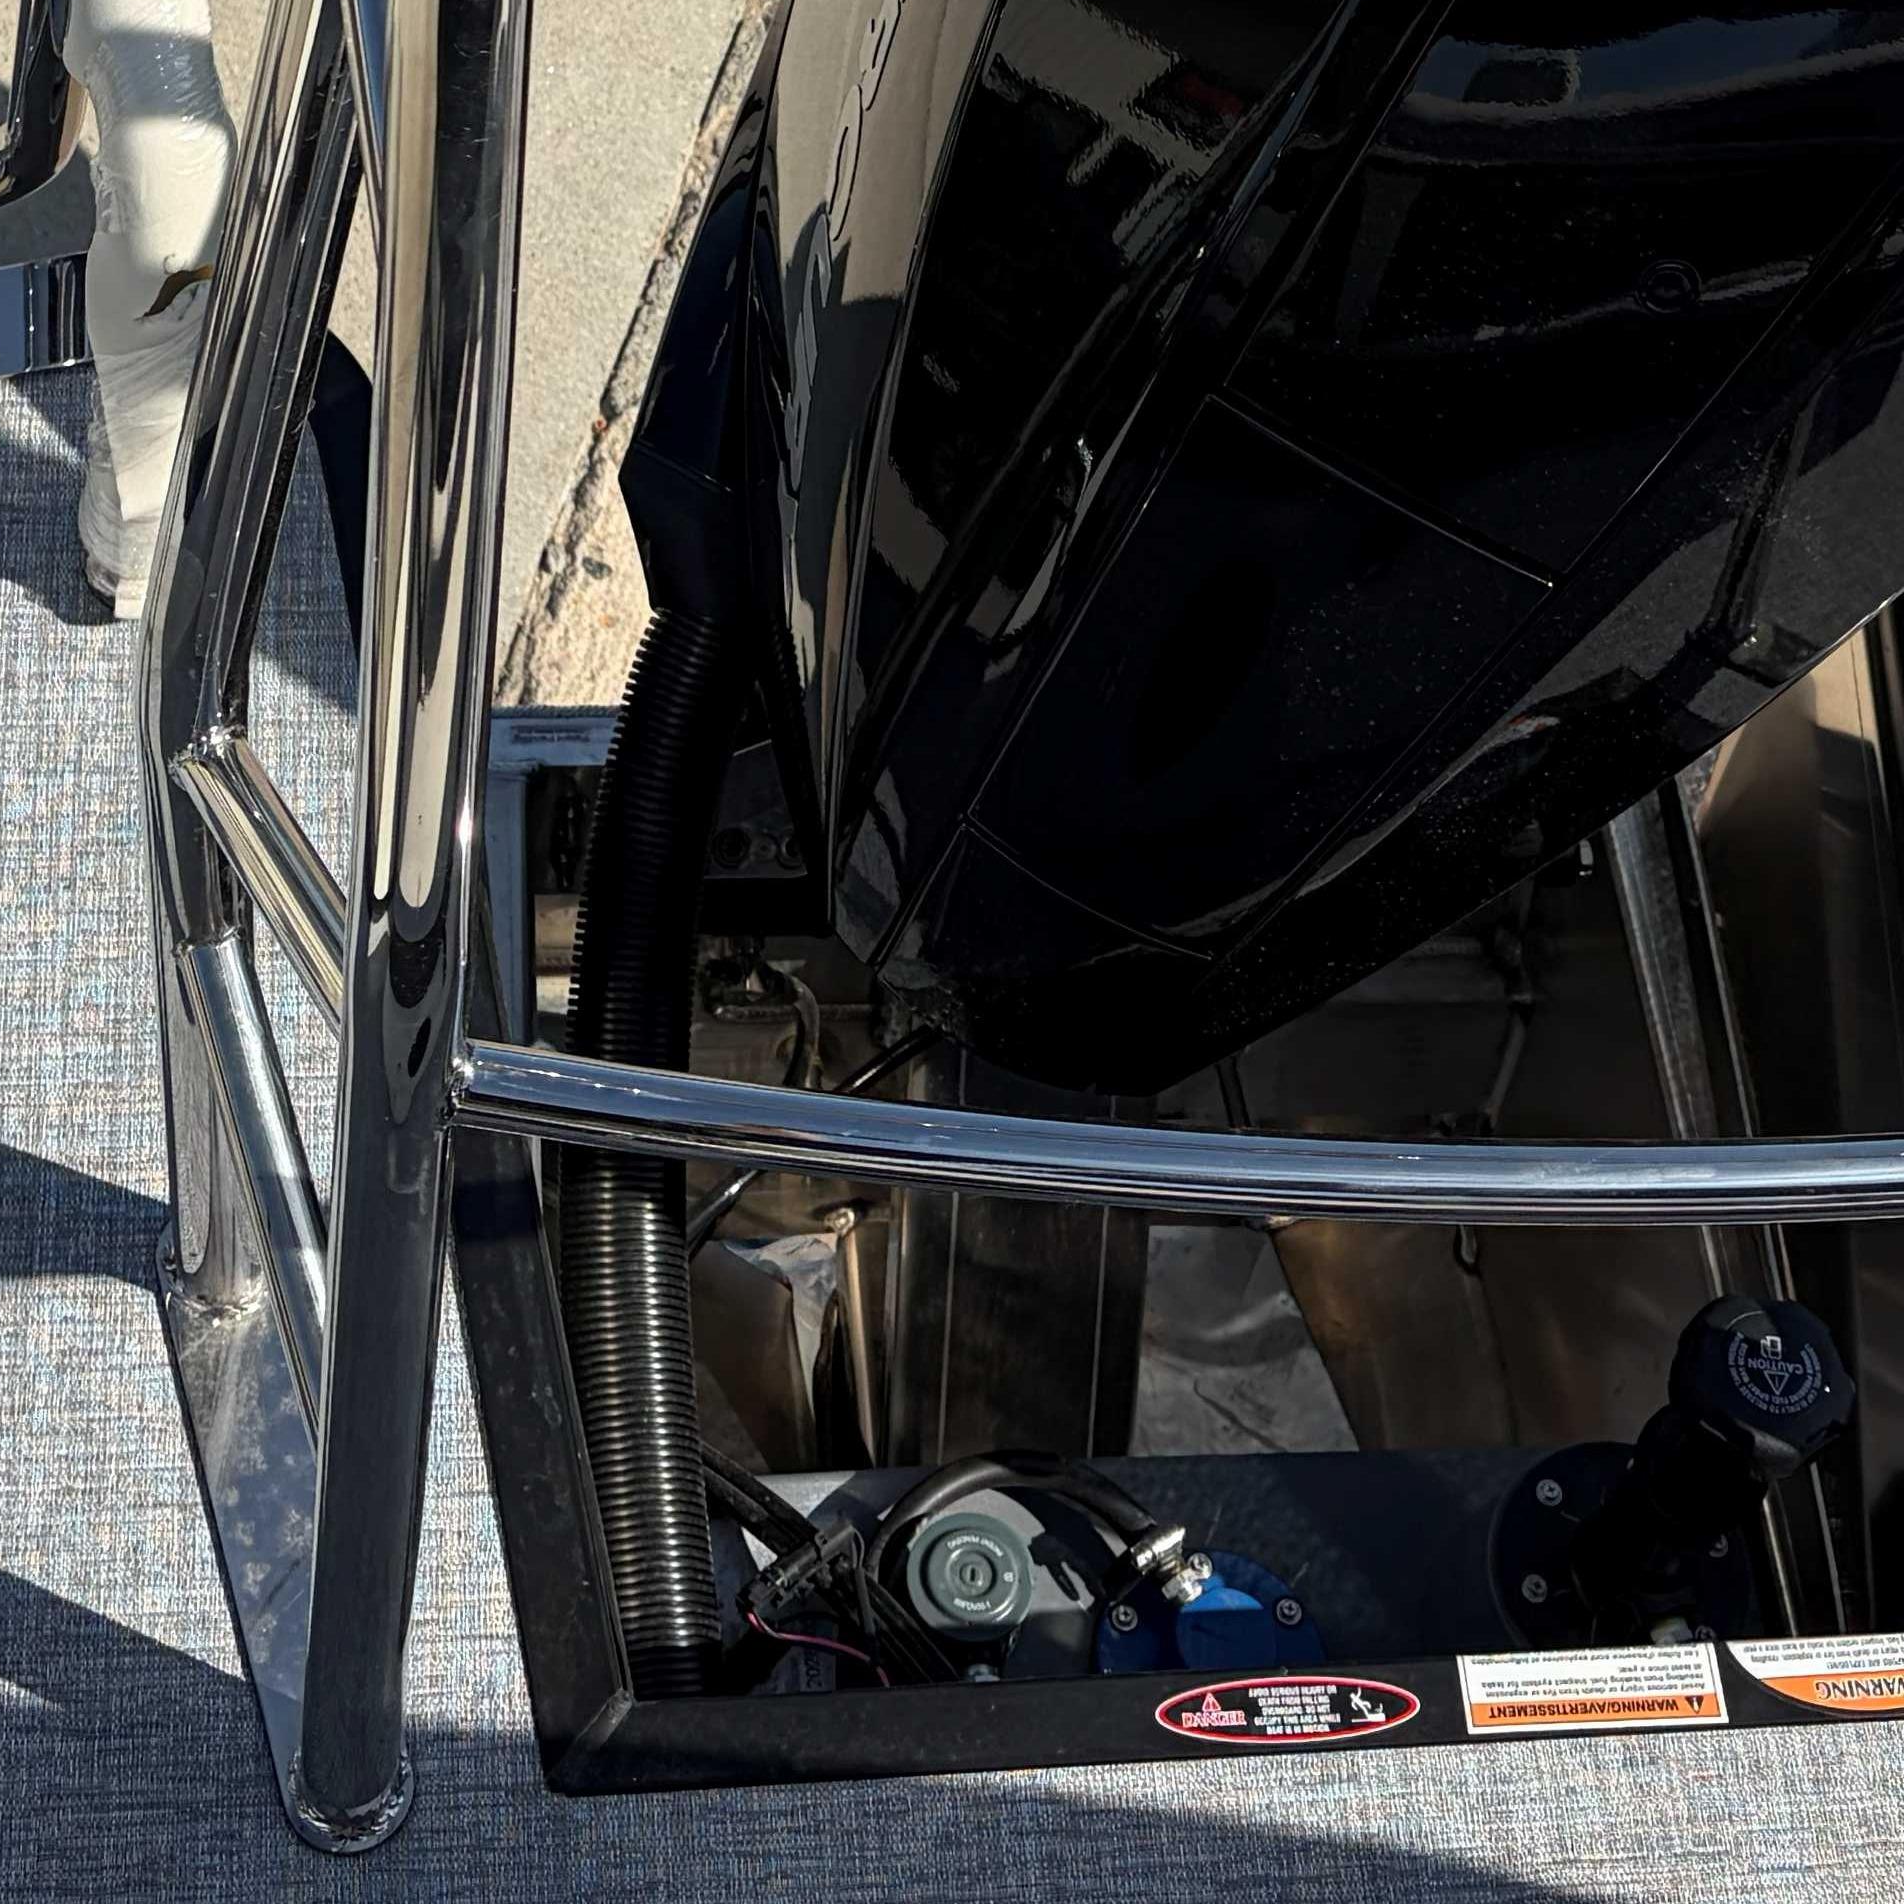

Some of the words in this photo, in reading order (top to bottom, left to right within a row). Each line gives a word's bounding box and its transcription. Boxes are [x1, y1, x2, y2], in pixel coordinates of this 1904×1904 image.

[1747, 1357, 1804, 1375] CAUTION
[1489, 1699, 1678, 1718] WARNING/AVERTISSEMENT
[1182, 1710, 1246, 1727] DANGER
